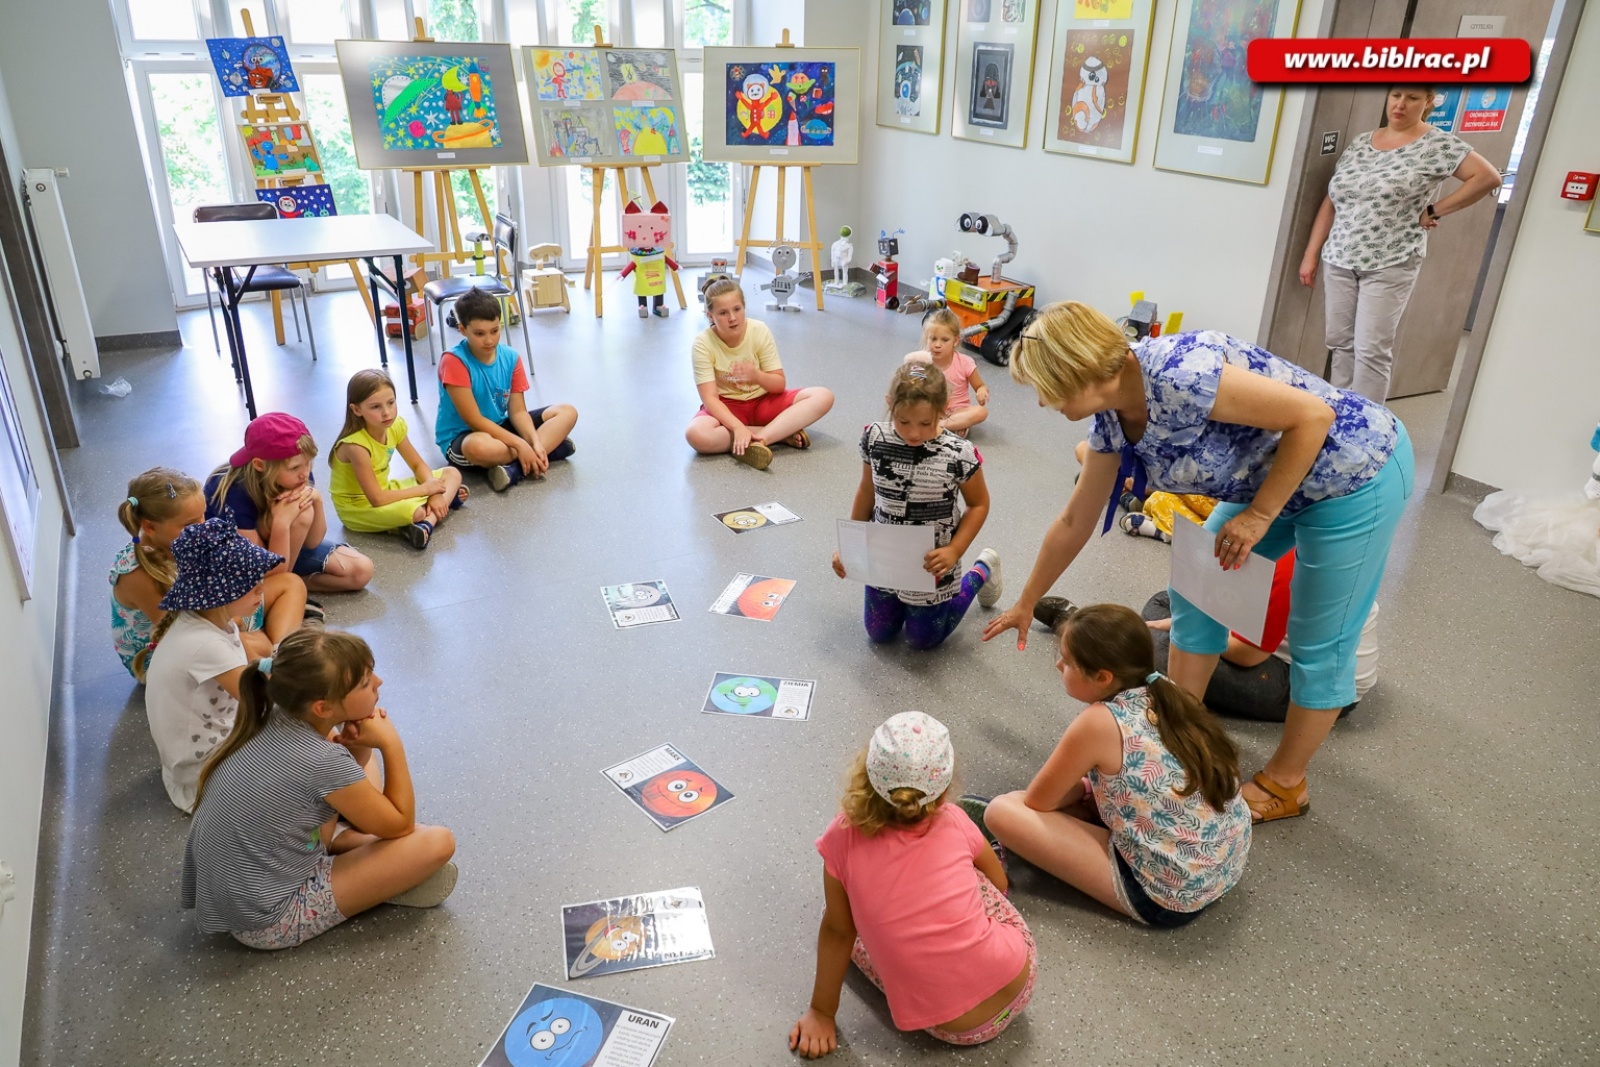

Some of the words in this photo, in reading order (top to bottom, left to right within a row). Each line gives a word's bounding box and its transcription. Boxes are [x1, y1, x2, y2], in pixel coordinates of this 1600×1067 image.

[1324, 134, 1336, 144] WC
[664, 747, 681, 761] MARS
[627, 1014, 660, 1029] URAN
